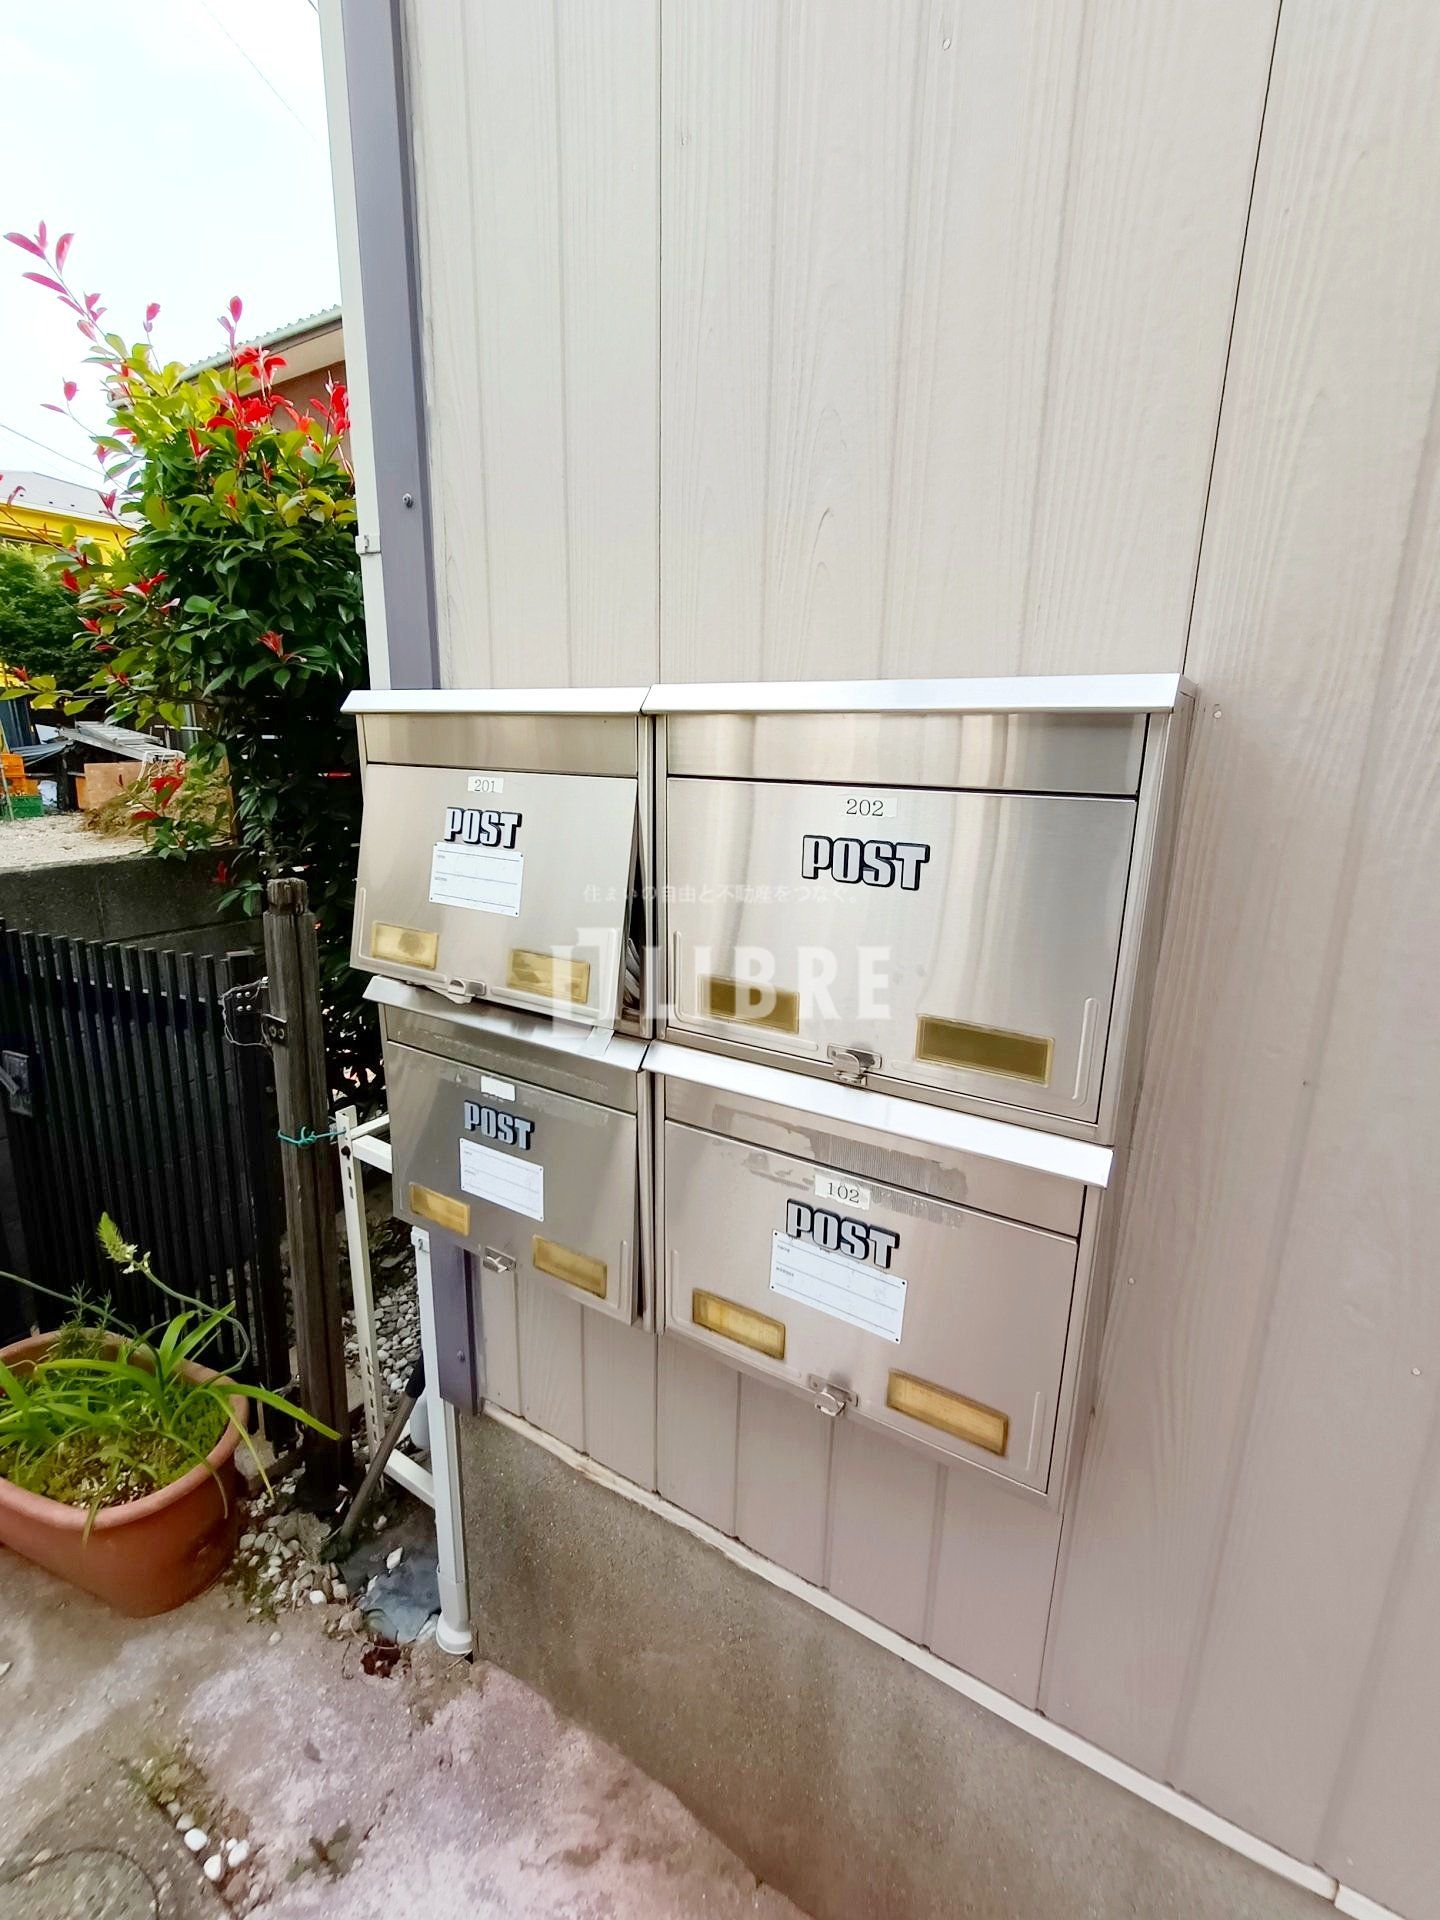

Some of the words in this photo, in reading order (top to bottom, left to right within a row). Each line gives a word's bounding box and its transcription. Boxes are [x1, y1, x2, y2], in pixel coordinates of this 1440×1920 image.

[474, 779, 496, 793] 201
[444, 806, 523, 849] POST
[845, 798, 884, 818] 202
[801, 835, 931, 891] POST
[463, 1100, 535, 1151] POST
[827, 1182, 860, 1204] 102
[786, 1198, 900, 1269] POST
